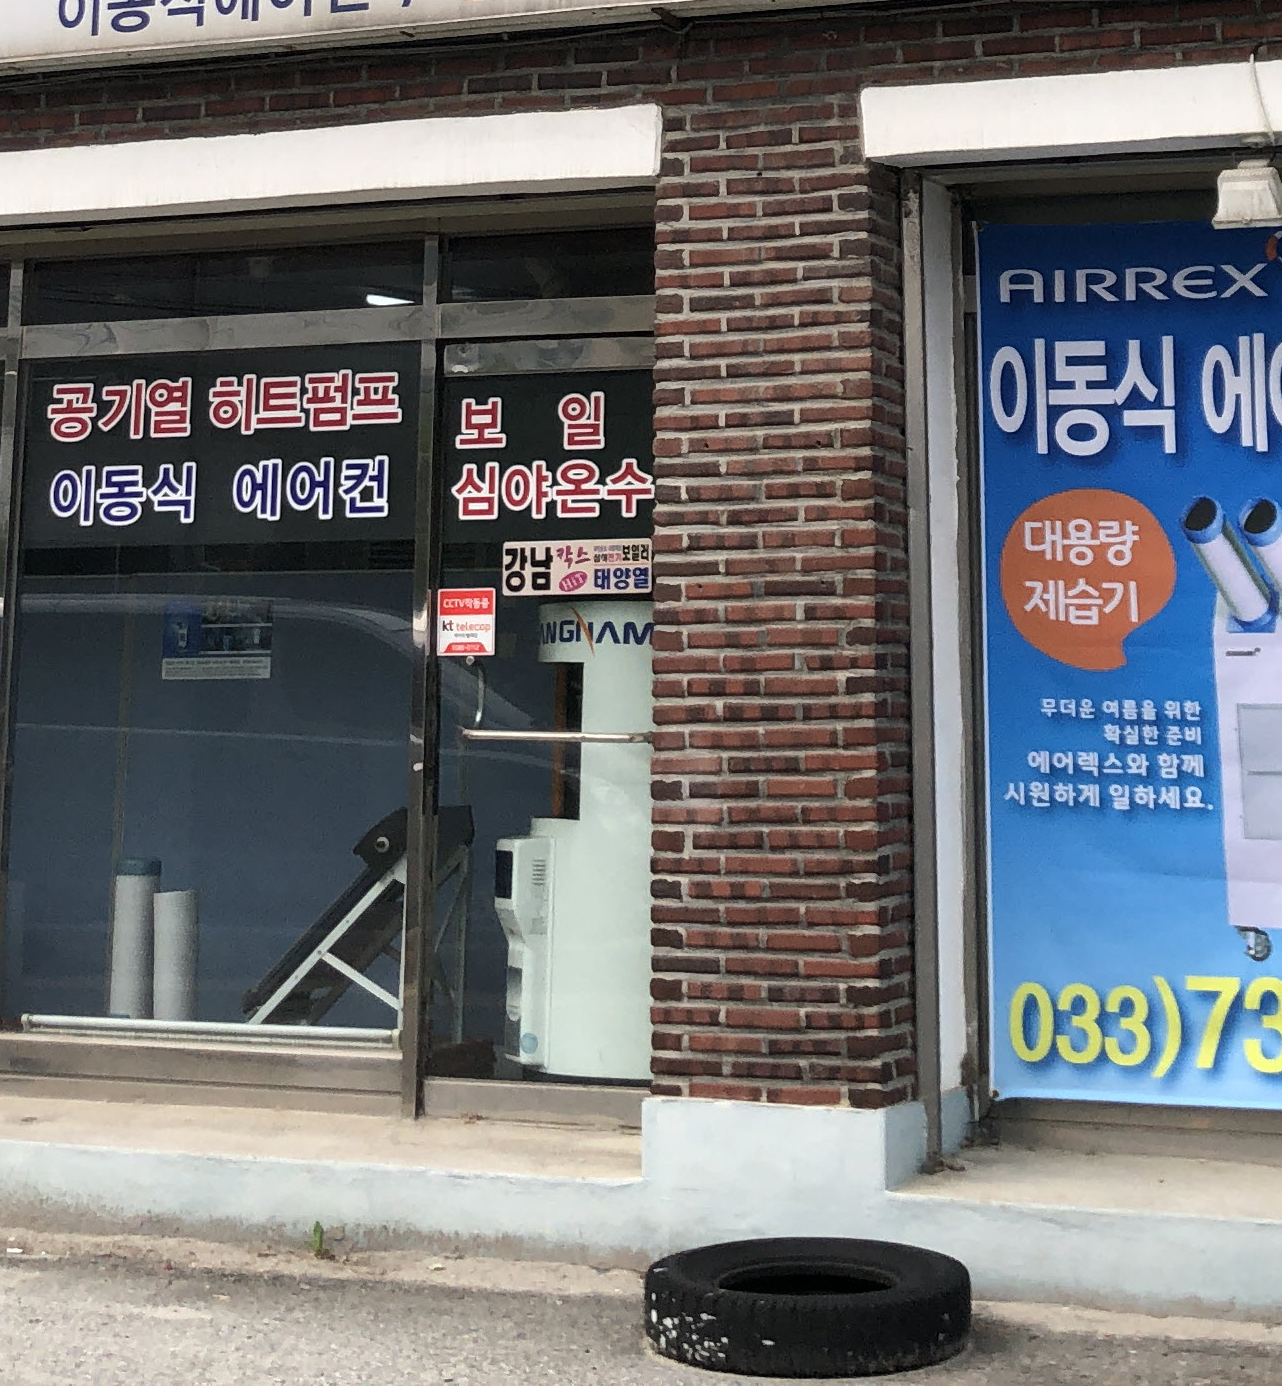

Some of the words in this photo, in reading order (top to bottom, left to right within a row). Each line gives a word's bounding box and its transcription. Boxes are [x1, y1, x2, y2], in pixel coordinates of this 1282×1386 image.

[999, 263, 1269, 304] AIRREX
[47, 376, 193, 442] 공기열
[209, 369, 403, 435] 히트펌프
[989, 333, 1177, 457] 이동식
[49, 461, 198, 527] 이동식
[232, 454, 391, 521] 에어컨
[1024, 519, 1140, 568] 대용량
[504, 546, 554, 592] 강남
[593, 566, 650, 590] 태양열
[1024, 579, 1140, 626] 제습기
[442, 619, 455, 632] kt
[1040, 697, 1096, 719] 무더운
[1102, 698, 1158, 721] 여름을
[1163, 700, 1202, 721] 위한
[1102, 723, 1159, 746] 확실한
[1166, 724, 1202, 746] 준비
[1027, 750, 1150, 777] 에어렉스와
[1157, 753, 1205, 779] 함께
[1003, 780, 1101, 807] 시원하게
[1108, 783, 1214, 811] 일하세요.
